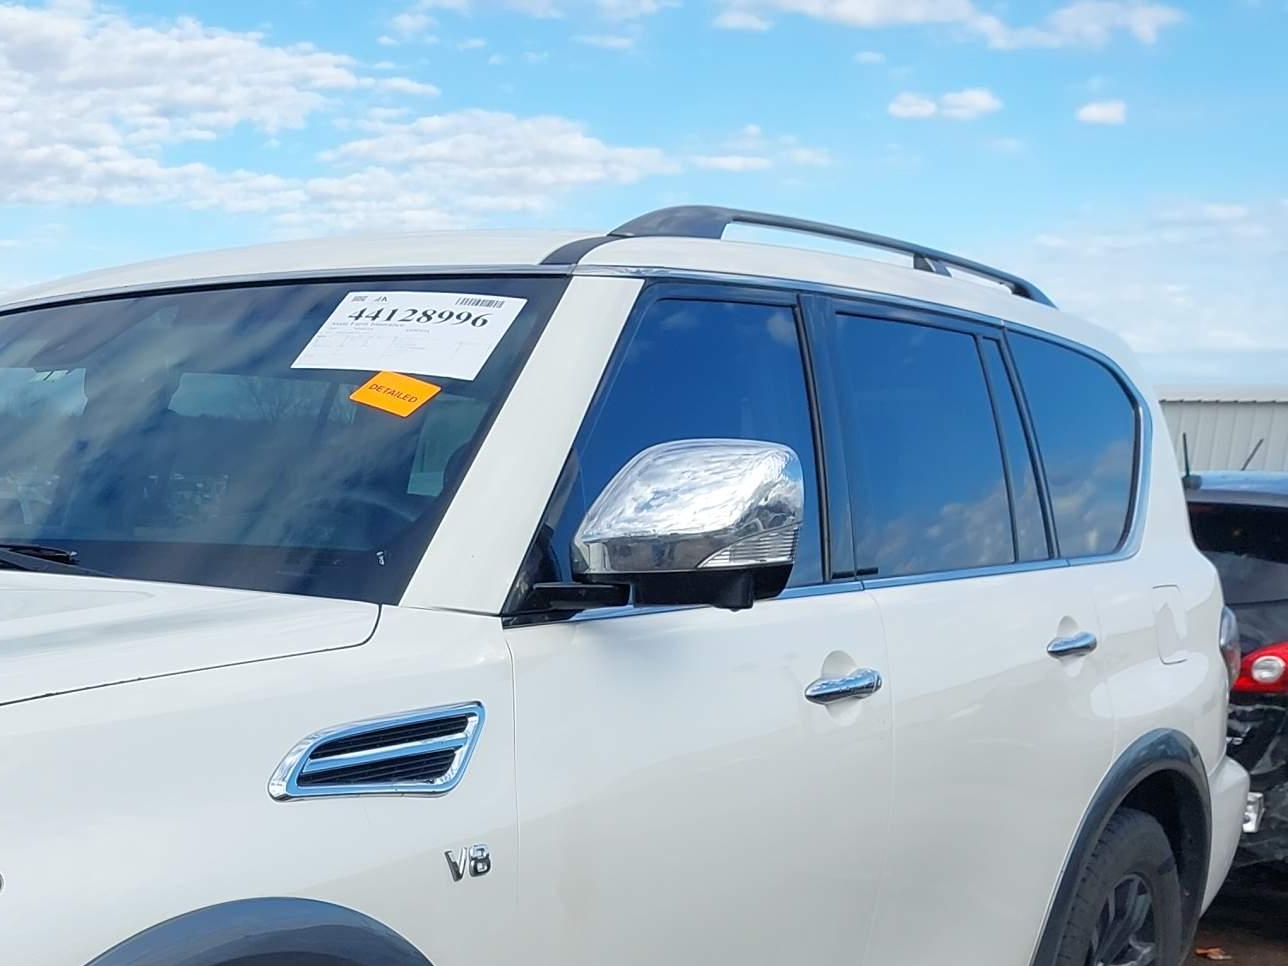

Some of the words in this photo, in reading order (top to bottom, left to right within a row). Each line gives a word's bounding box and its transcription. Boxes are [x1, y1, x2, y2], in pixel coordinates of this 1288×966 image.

[348, 307, 495, 328] 44128996
[368, 383, 418, 404] DETAILED
[444, 843, 491, 882] V8
